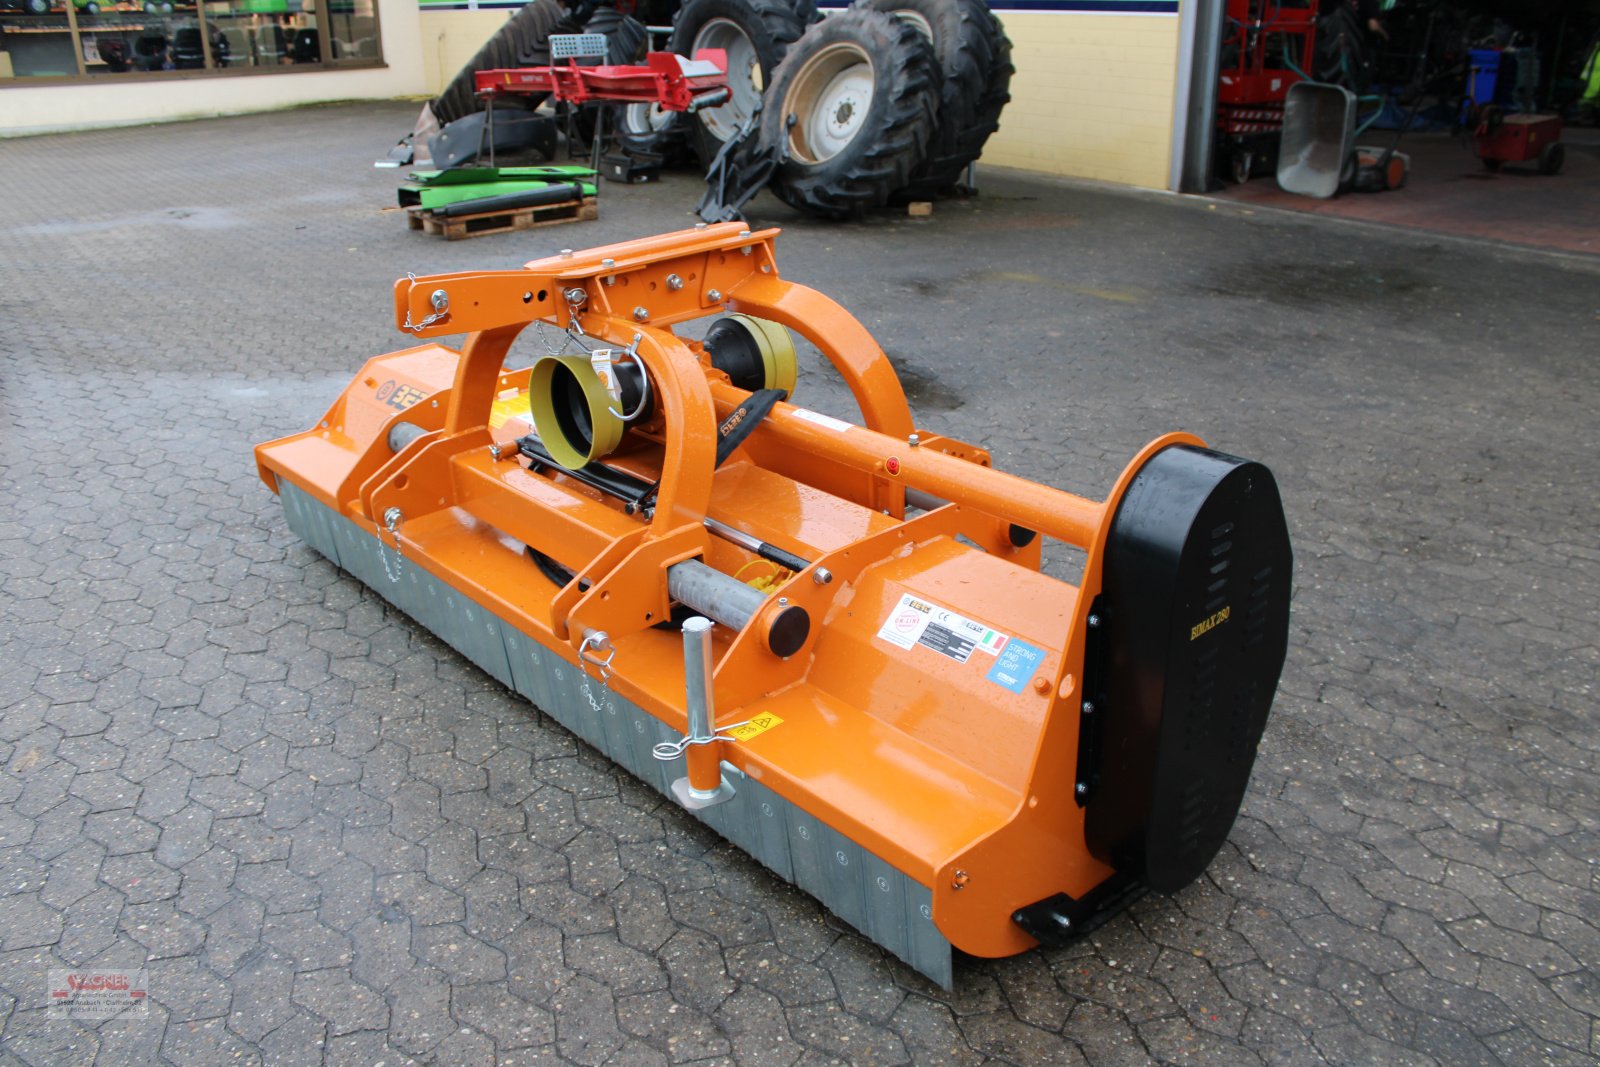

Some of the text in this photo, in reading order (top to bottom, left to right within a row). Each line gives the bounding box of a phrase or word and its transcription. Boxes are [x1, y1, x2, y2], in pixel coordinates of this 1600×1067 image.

[1190, 614, 1216, 641] BIMAX
[1003, 651, 1018, 663] AND
[1008, 643, 1037, 661] STRONG
[998, 660, 1019, 672] LIGHT
